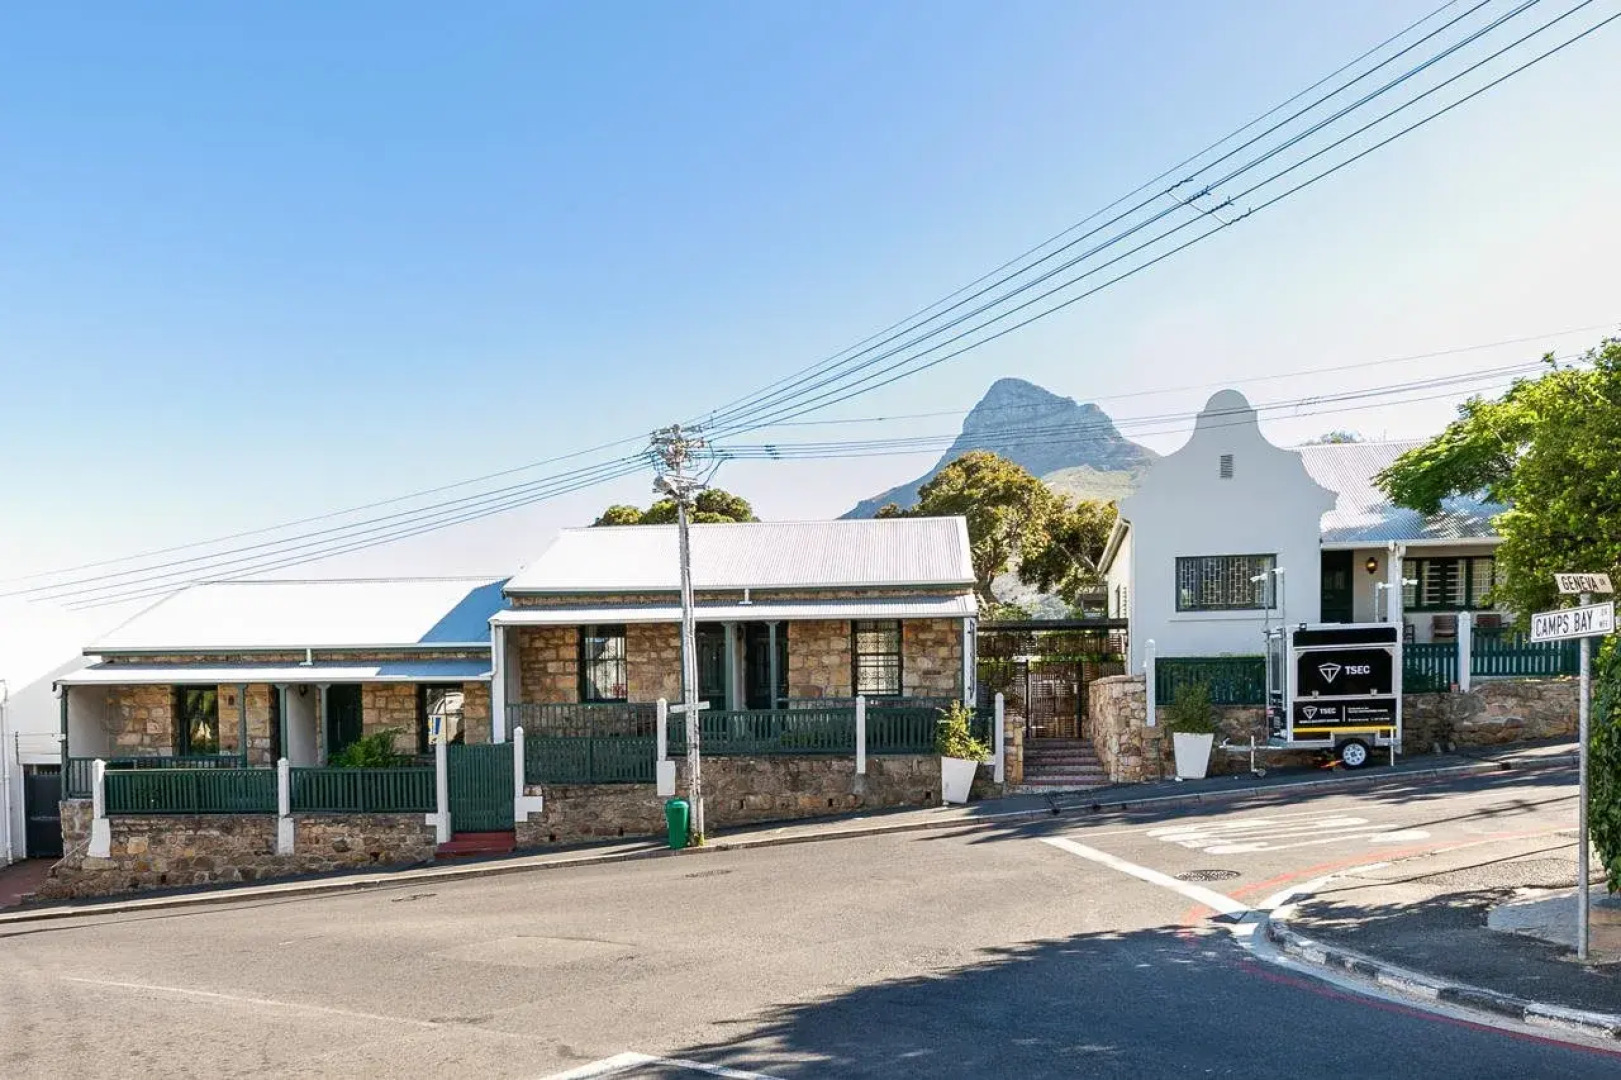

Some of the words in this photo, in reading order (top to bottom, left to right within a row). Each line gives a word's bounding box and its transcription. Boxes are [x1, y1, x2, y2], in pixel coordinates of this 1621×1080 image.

[1561, 575, 1599, 591] GENEVA
[1536, 614, 1569, 637] CAMPS
[1574, 610, 1593, 632] BAY
[1345, 665, 1370, 675] TSEC
